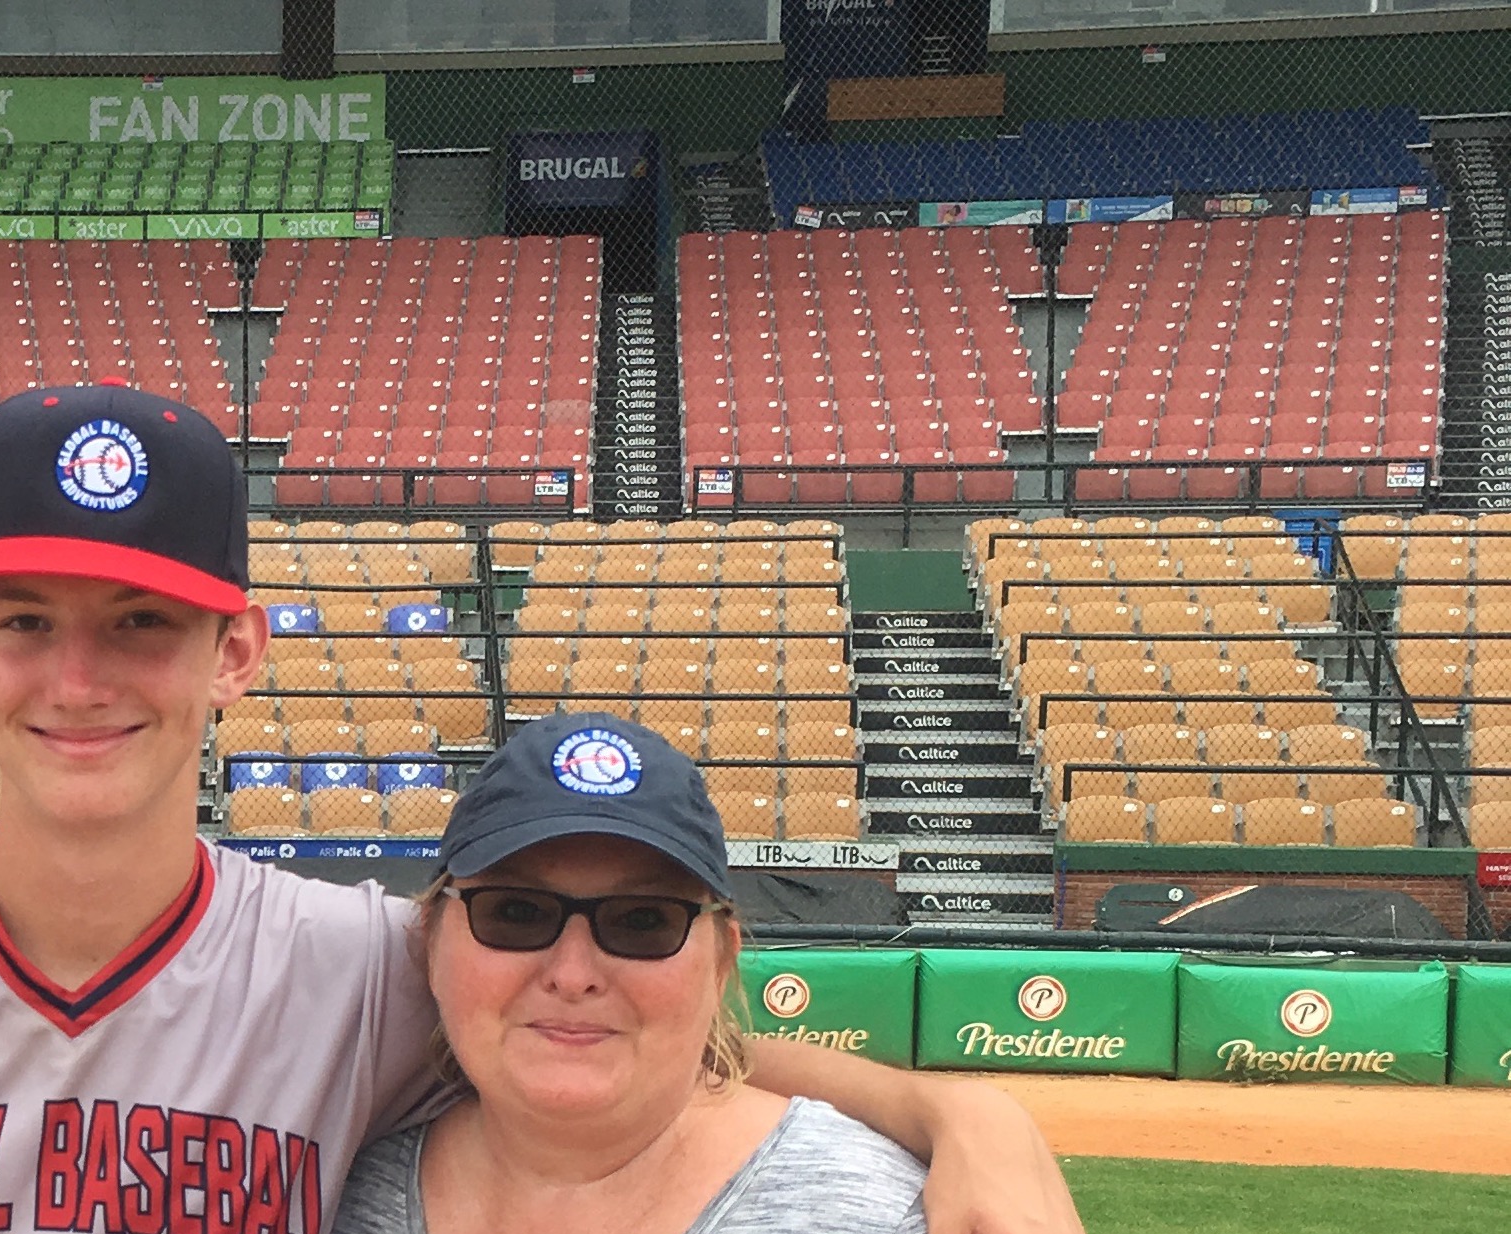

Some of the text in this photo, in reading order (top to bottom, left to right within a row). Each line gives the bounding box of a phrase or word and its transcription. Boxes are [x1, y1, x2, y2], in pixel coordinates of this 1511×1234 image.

[90, 93, 372, 143] FAN ZONE
[519, 156, 626, 181] BRUGAL
[629, 400, 655, 408] altice
[629, 413, 655, 421] altice
[58, 420, 149, 477] GLOBAL BASEBALL
[61, 478, 138, 510] ADVENTURES
[631, 490, 659, 498] altice
[893, 616, 927, 628] altice
[899, 636, 935, 647] altice
[902, 661, 939, 672] altice
[906, 687, 944, 698] altice
[913, 715, 952, 727] altice
[919, 747, 959, 759] altice
[922, 781, 963, 793] altice
[929, 816, 972, 829] altice
[250, 846, 276, 858] Palic
[336, 846, 362, 858] Palic
[756, 845, 782, 864] LTB
[833, 845, 860, 865] LTB
[936, 858, 981, 870] altice
[945, 897, 991, 910] altice
[956, 1022, 1126, 1058] Presidente
[1217, 1039, 1396, 1074] Presidente
